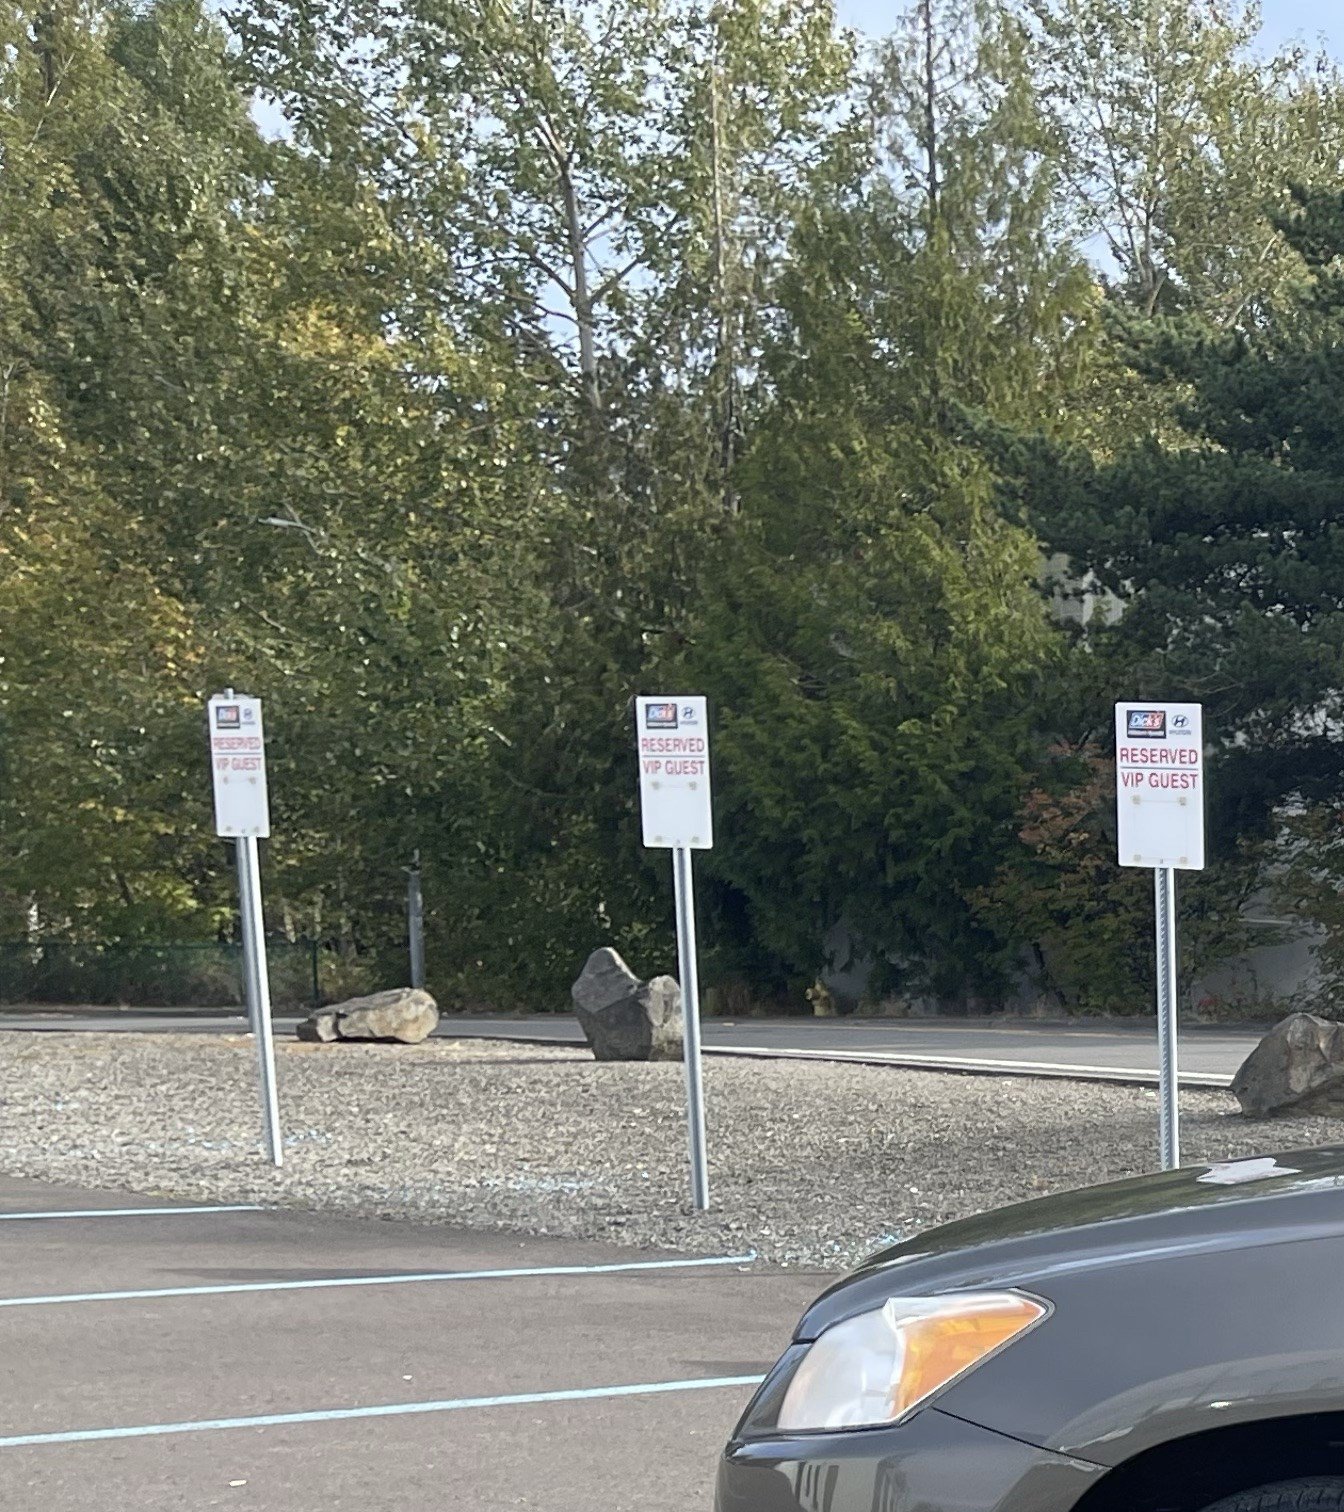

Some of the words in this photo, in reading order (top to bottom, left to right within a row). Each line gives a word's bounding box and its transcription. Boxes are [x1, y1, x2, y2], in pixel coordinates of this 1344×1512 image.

[642, 738, 705, 752] RESERVED
[1120, 748, 1198, 764] RESERVED
[643, 760, 662, 774] VIP
[665, 760, 705, 775] GUEST
[1121, 772, 1144, 787] VIP
[1149, 772, 1198, 789] GUEST
